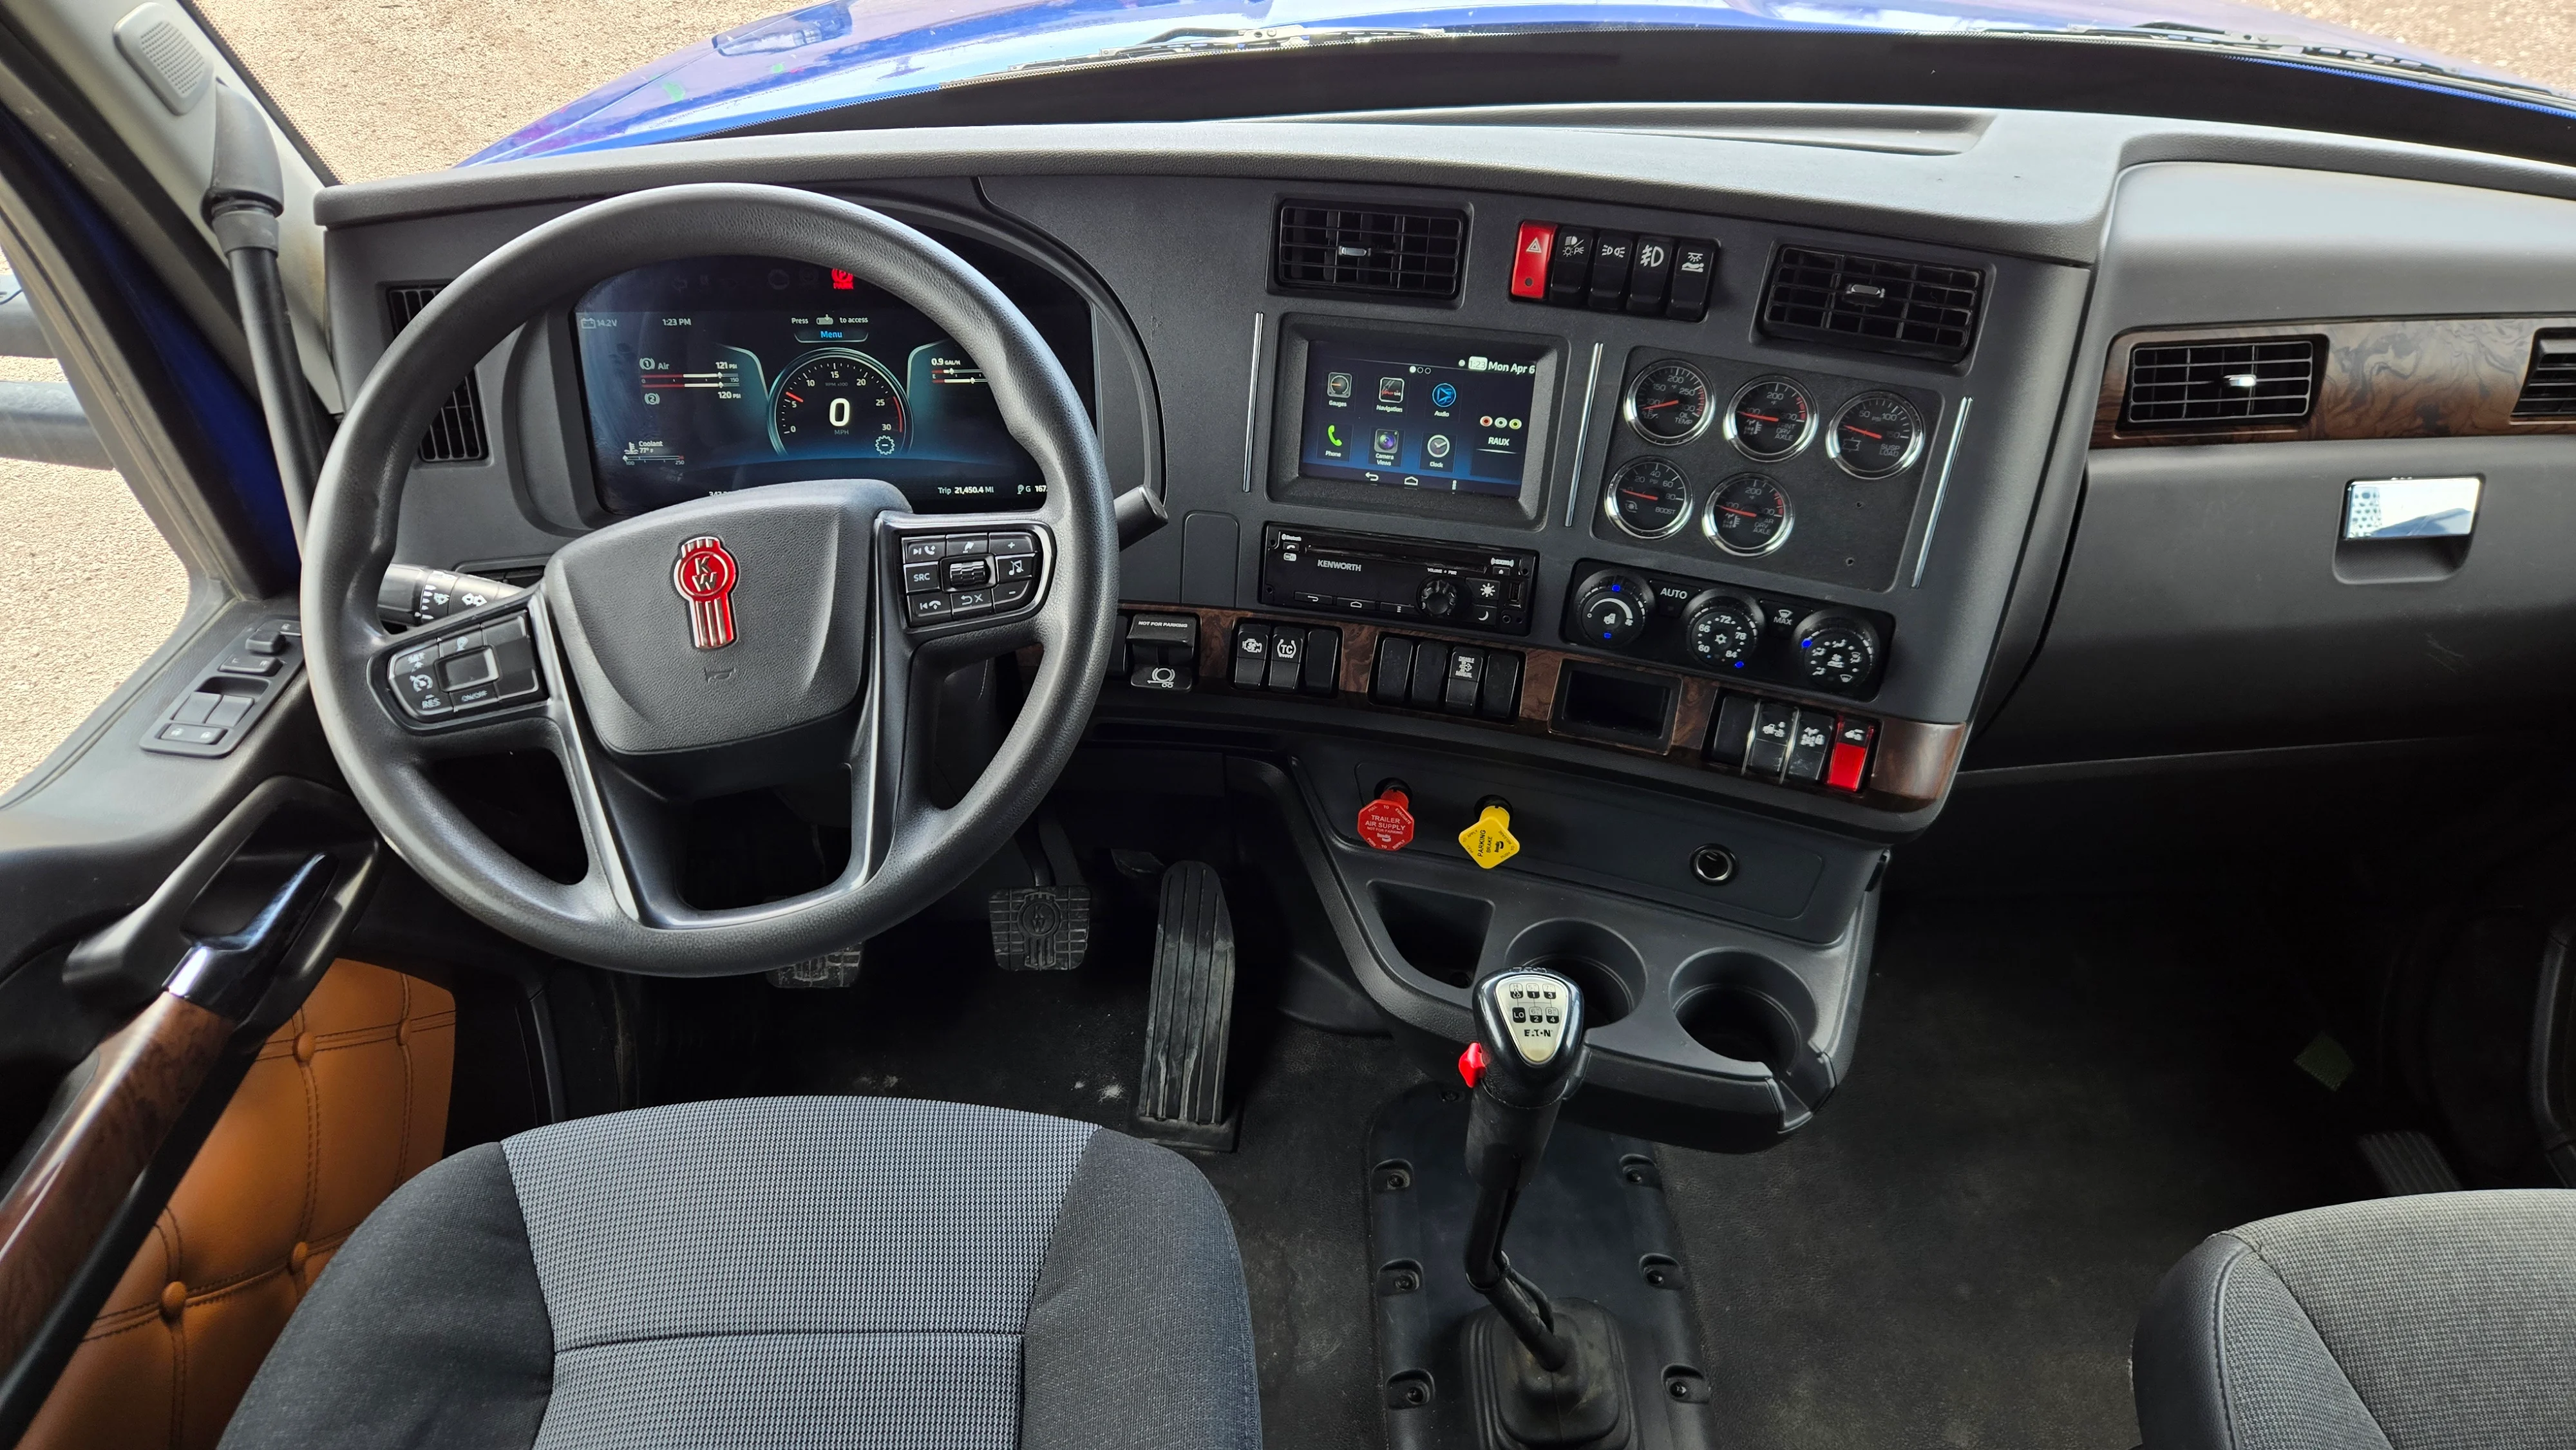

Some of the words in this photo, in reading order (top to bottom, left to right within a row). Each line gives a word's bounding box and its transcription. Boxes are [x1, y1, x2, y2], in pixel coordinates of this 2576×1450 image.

[597, 319, 618, 327] 14.2V
[715, 361, 728, 370] 121
[931, 357, 944, 366] 0.9
[1469, 361, 1486, 369] 1:23
[1488, 361, 1510, 372] Mon
[1510, 362, 1528, 375] Apr
[1528, 365, 1535, 374] 6
[1667, 375, 1684, 384] 200
[1653, 383, 1667, 391] 150
[718, 391, 732, 399] 120
[1678, 388, 1696, 397] 250
[1766, 391, 1785, 400] 200
[1328, 400, 1347, 408] Gauges
[1376, 404, 1403, 413] Navigation
[829, 397, 850, 427] 0
[1434, 410, 1450, 418] Audio
[1674, 417, 1693, 425] TEMP
[1881, 413, 1898, 422] 100
[1488, 436, 1510, 447] RAUX
[1774, 433, 1794, 441] AXLE
[1879, 449, 1900, 457] LOAD
[1662, 480, 1674, 488] 60
[937, 487, 952, 495] Trip
[954, 486, 984, 494] 21,450.4
[1745, 487, 1762, 495] 200
[1655, 506, 1676, 515] BOOST
[1752, 527, 1772, 535] AXLE
[1317, 559, 1362, 572] KENWORTH
[913, 572, 931, 582] SRC
[1660, 587, 1688, 599] AUTO
[1719, 615, 1732, 624] 72
[1773, 616, 1793, 626] MAX
[1698, 623, 1710, 633] 66
[1735, 632, 1747, 641] 78
[1280, 645, 1294, 655] TC
[1698, 645, 1710, 653] 60
[1725, 650, 1738, 658] 84
[1371, 814, 1401, 824] TRAILER
[1378, 822, 1406, 831] SUPPLY
[1477, 829, 1486, 858] PARKING
